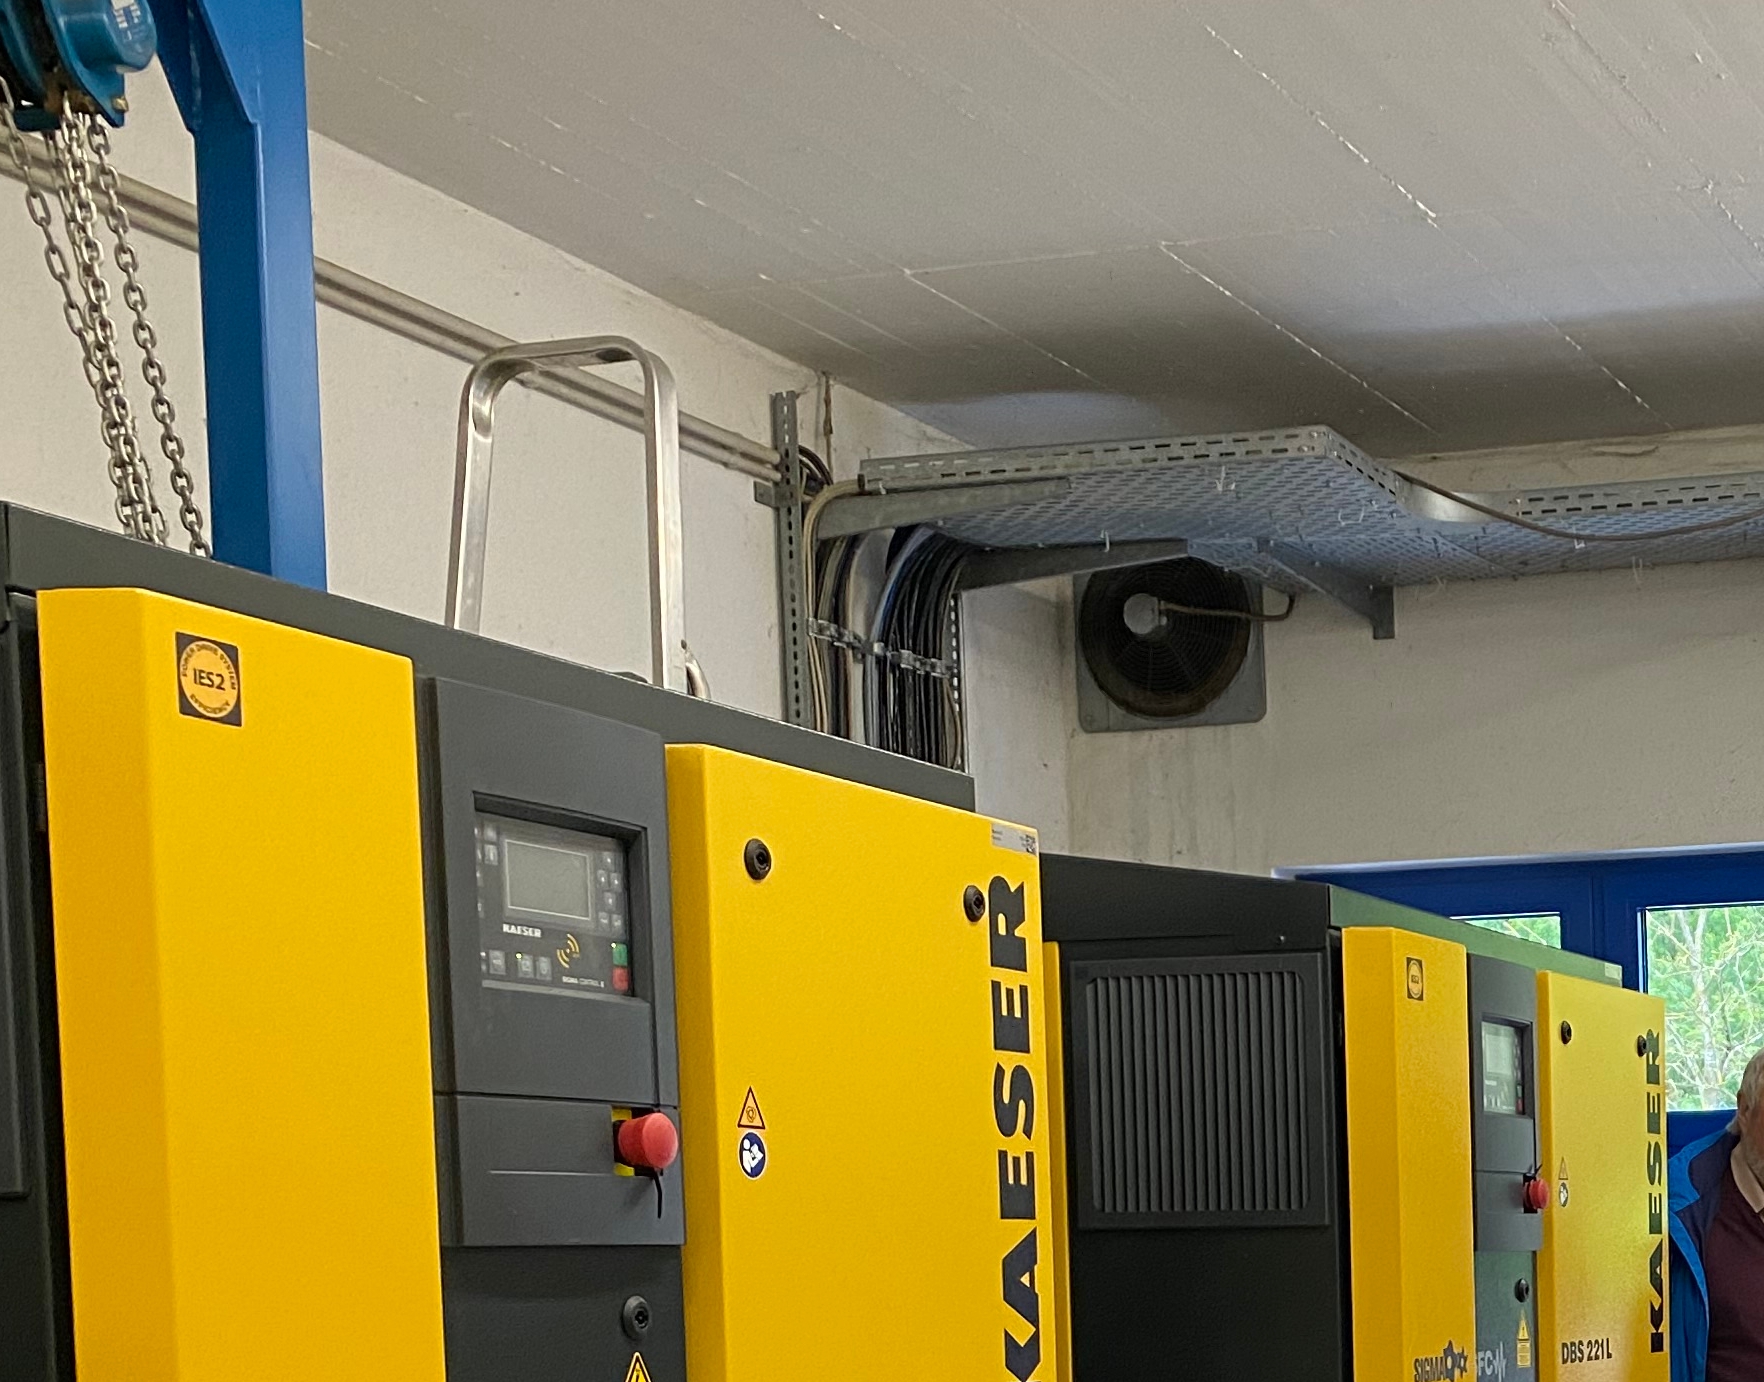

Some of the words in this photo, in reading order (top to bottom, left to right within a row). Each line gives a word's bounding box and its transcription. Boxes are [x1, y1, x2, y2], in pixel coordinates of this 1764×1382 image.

[193, 667, 226, 692] IES2
[502, 923, 542, 938] KAESER
[1646, 1029, 1664, 1353] KAESER
[1477, 1349, 1493, 1377] FC
[1561, 1338, 1585, 1365] DBS
[1586, 1338, 1605, 1362] 221
